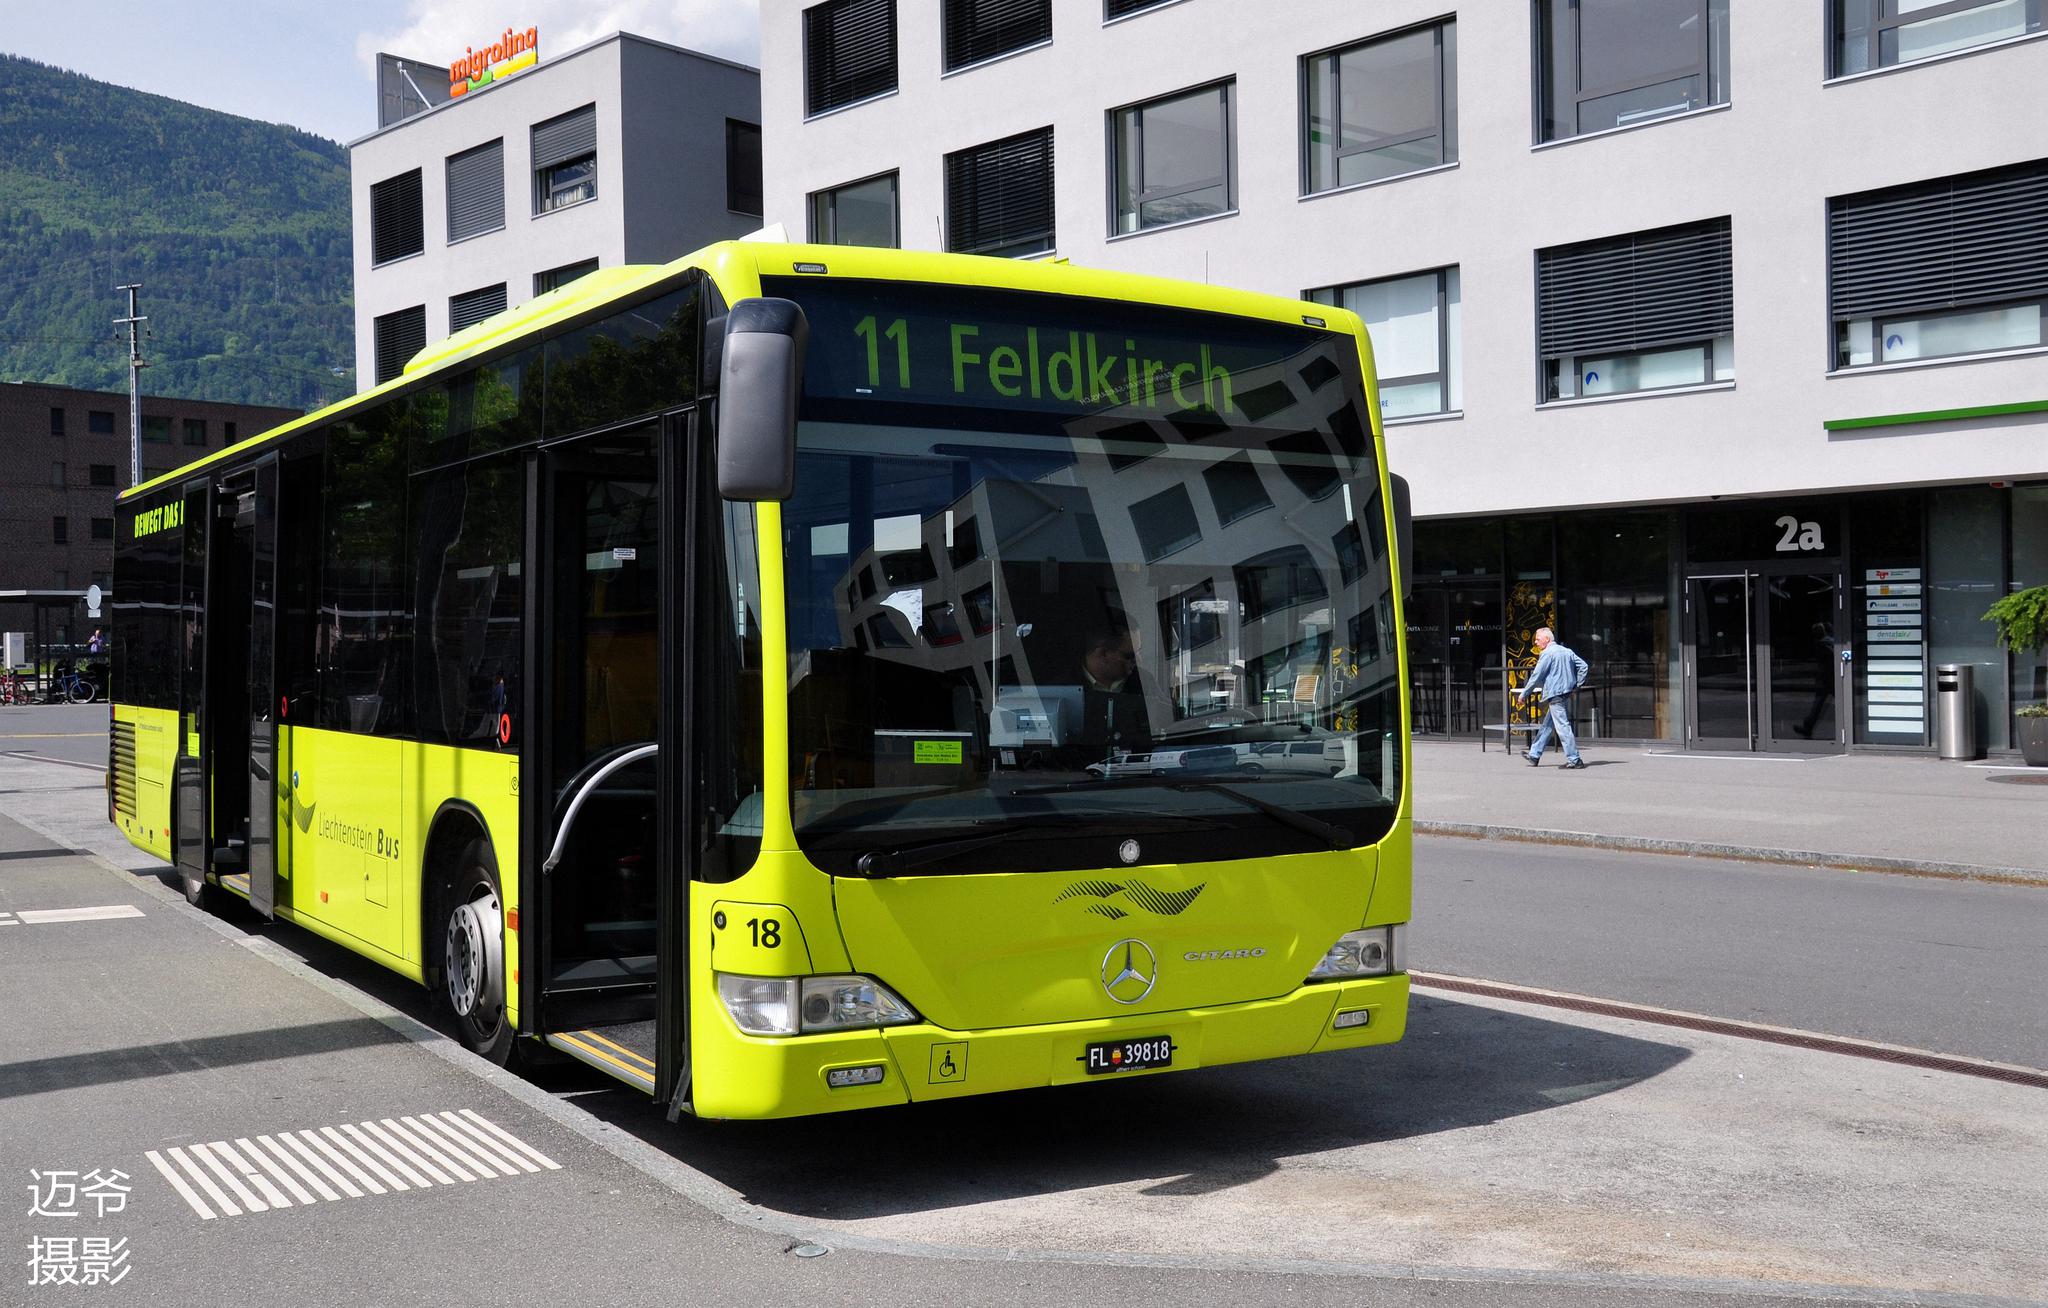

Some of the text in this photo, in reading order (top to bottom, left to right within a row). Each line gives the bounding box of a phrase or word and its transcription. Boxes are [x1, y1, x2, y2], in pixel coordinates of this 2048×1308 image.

[450, 27, 537, 82] migrolino
[853, 315, 1233, 414] 11 Feldkirch
[134, 507, 163, 539] BEWEGT
[164, 501, 179, 530] DAS
[1775, 515, 1825, 551] 2a
[318, 812, 399, 860] Liechtenstein Bus
[746, 918, 782, 949] 18
[1184, 947, 1267, 962] CITARO
[1090, 1040, 1170, 1068] FL 39818
